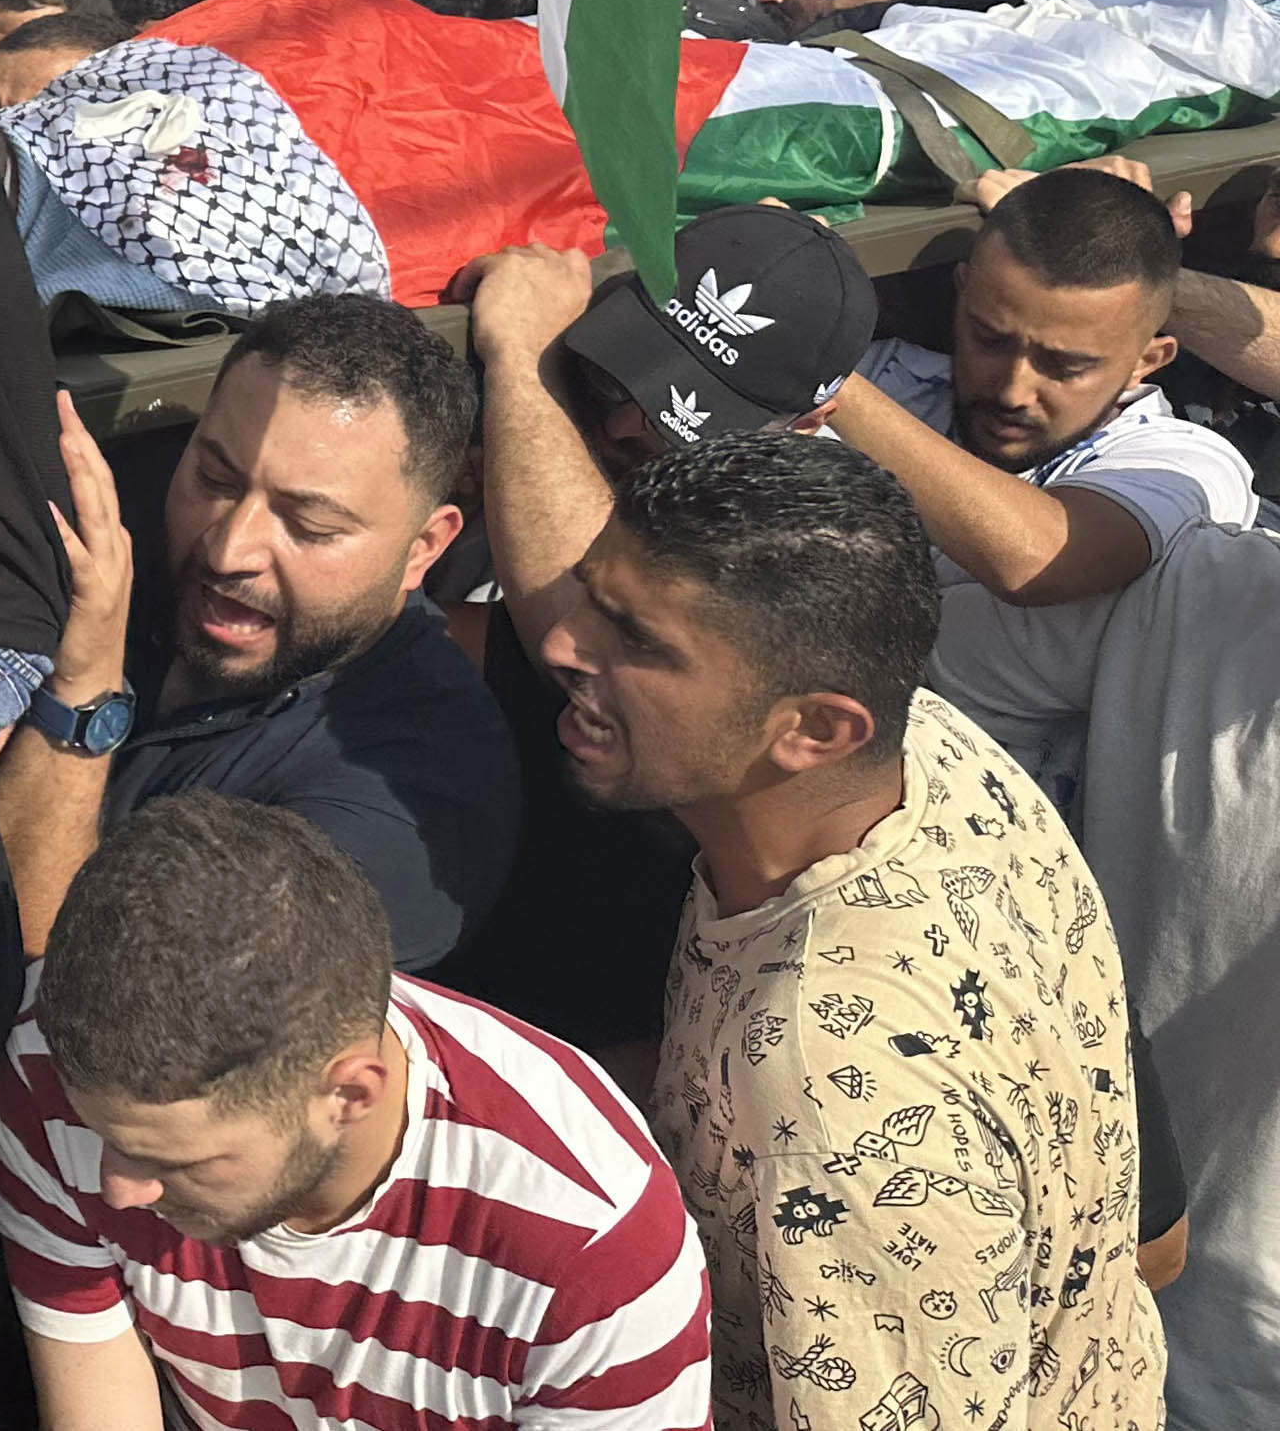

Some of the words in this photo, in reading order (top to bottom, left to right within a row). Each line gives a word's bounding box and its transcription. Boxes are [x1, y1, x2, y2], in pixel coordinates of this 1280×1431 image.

[666, 298, 739, 365] adidas
[809, 993, 843, 1020] BAD
[948, 1112, 974, 1173] HOPES
[883, 1240, 922, 1271] LOVE
[897, 1222, 938, 1257] HATE
[975, 1229, 1018, 1265] HOPES
